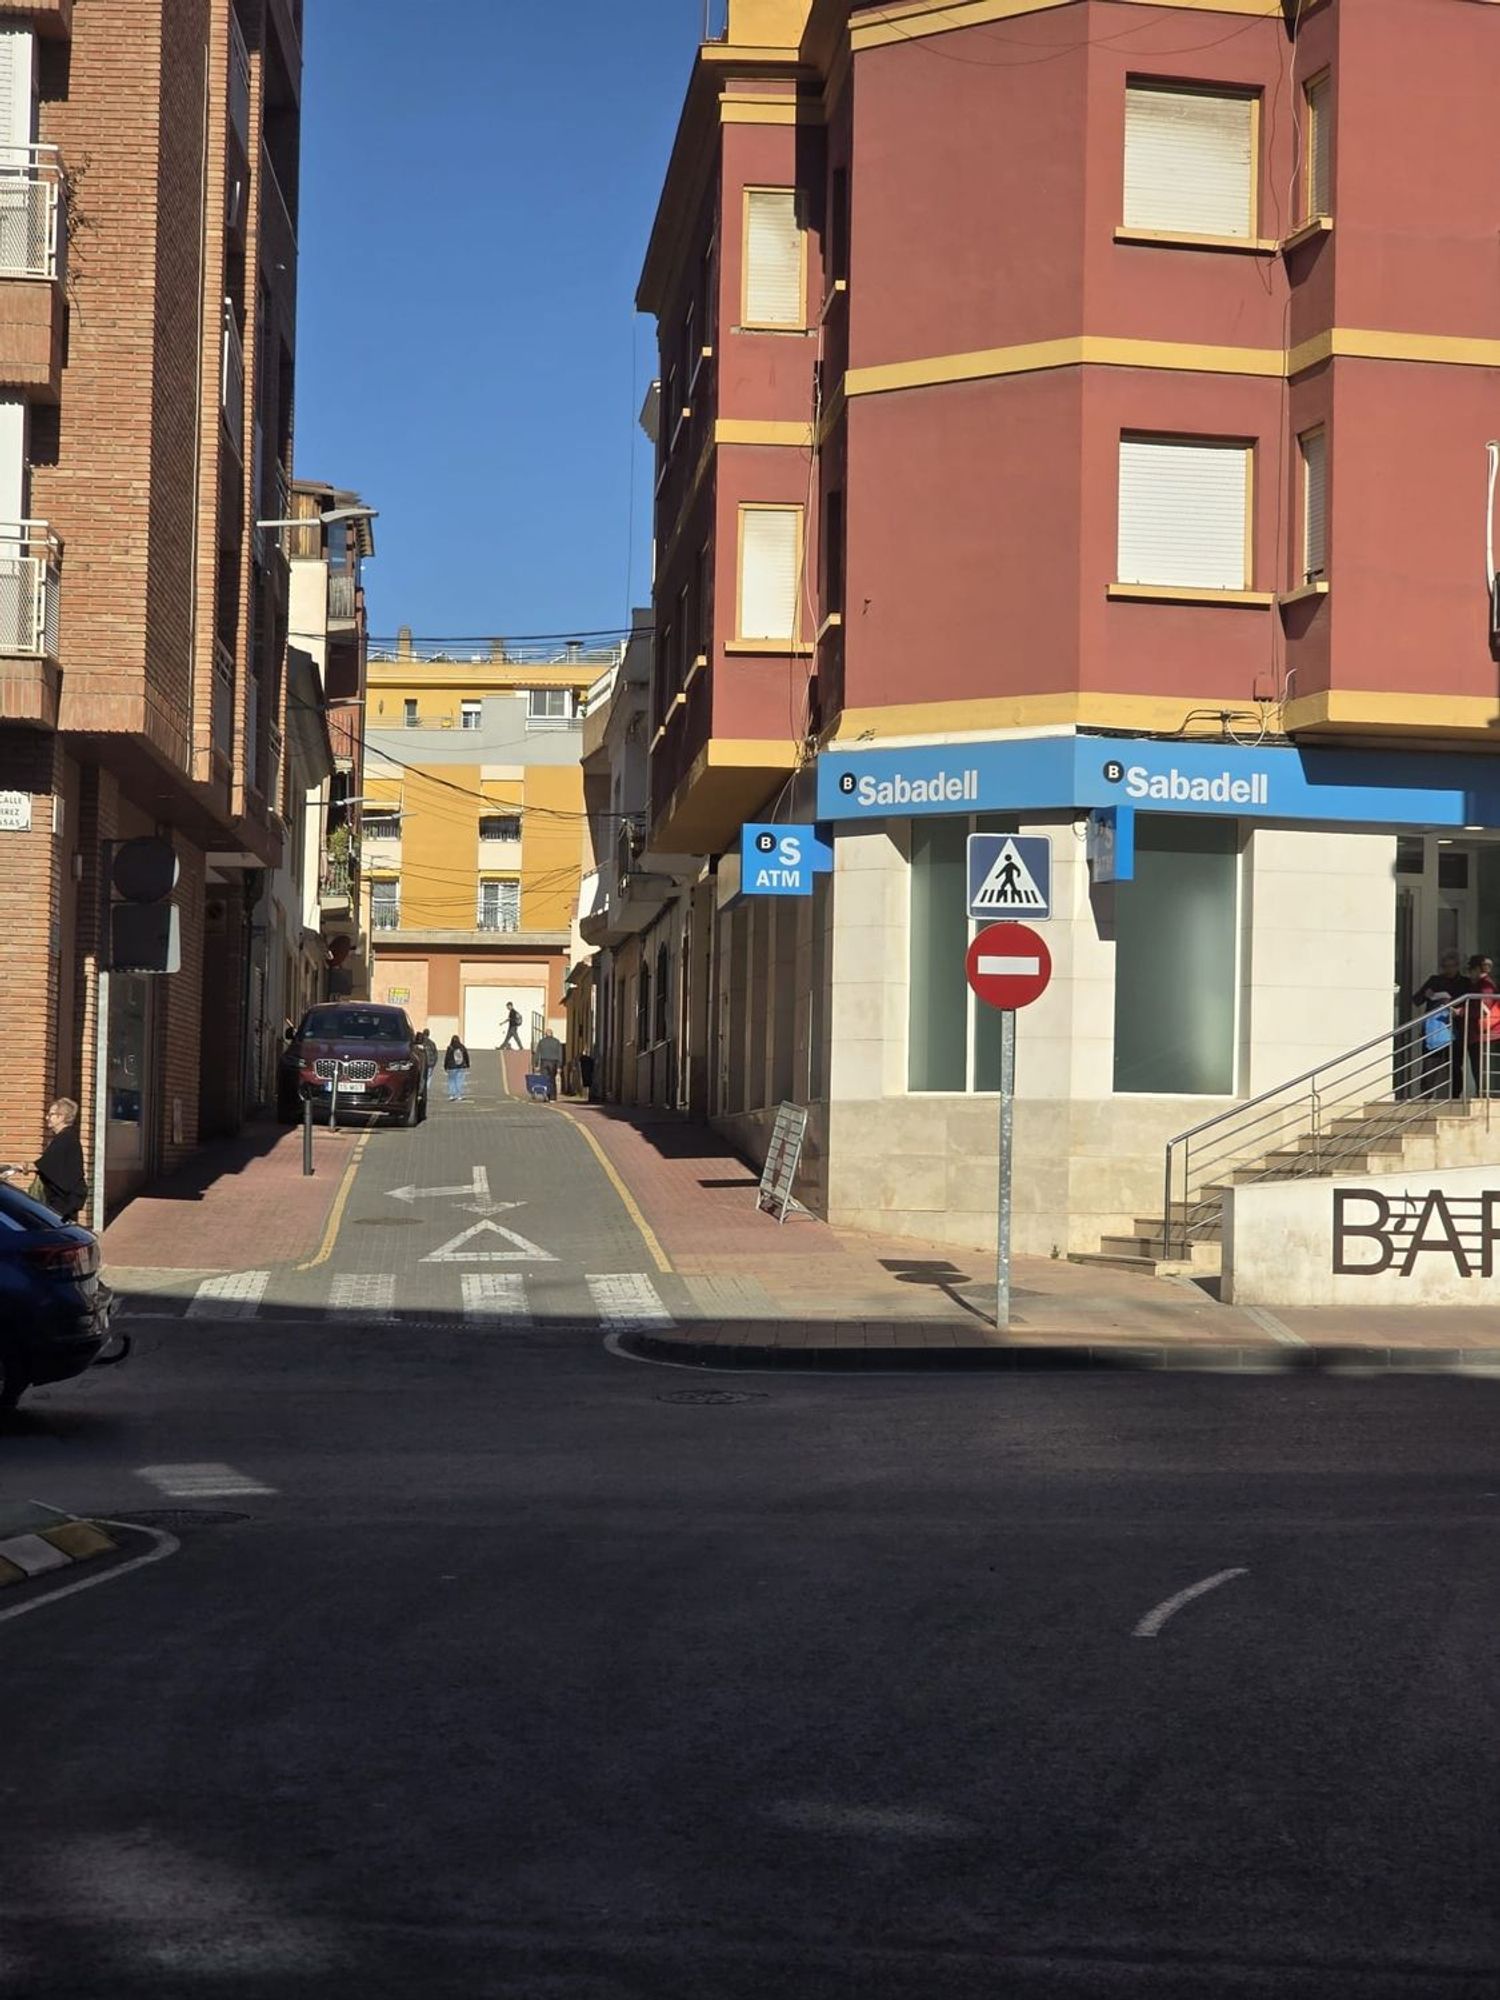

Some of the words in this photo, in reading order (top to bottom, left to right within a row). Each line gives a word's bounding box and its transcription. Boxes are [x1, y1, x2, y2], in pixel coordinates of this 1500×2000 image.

[857, 770, 978, 806] Sabadell
[1125, 766, 1268, 804] Sabadell
[779, 837, 801, 866] S
[756, 870, 800, 888] ATM
